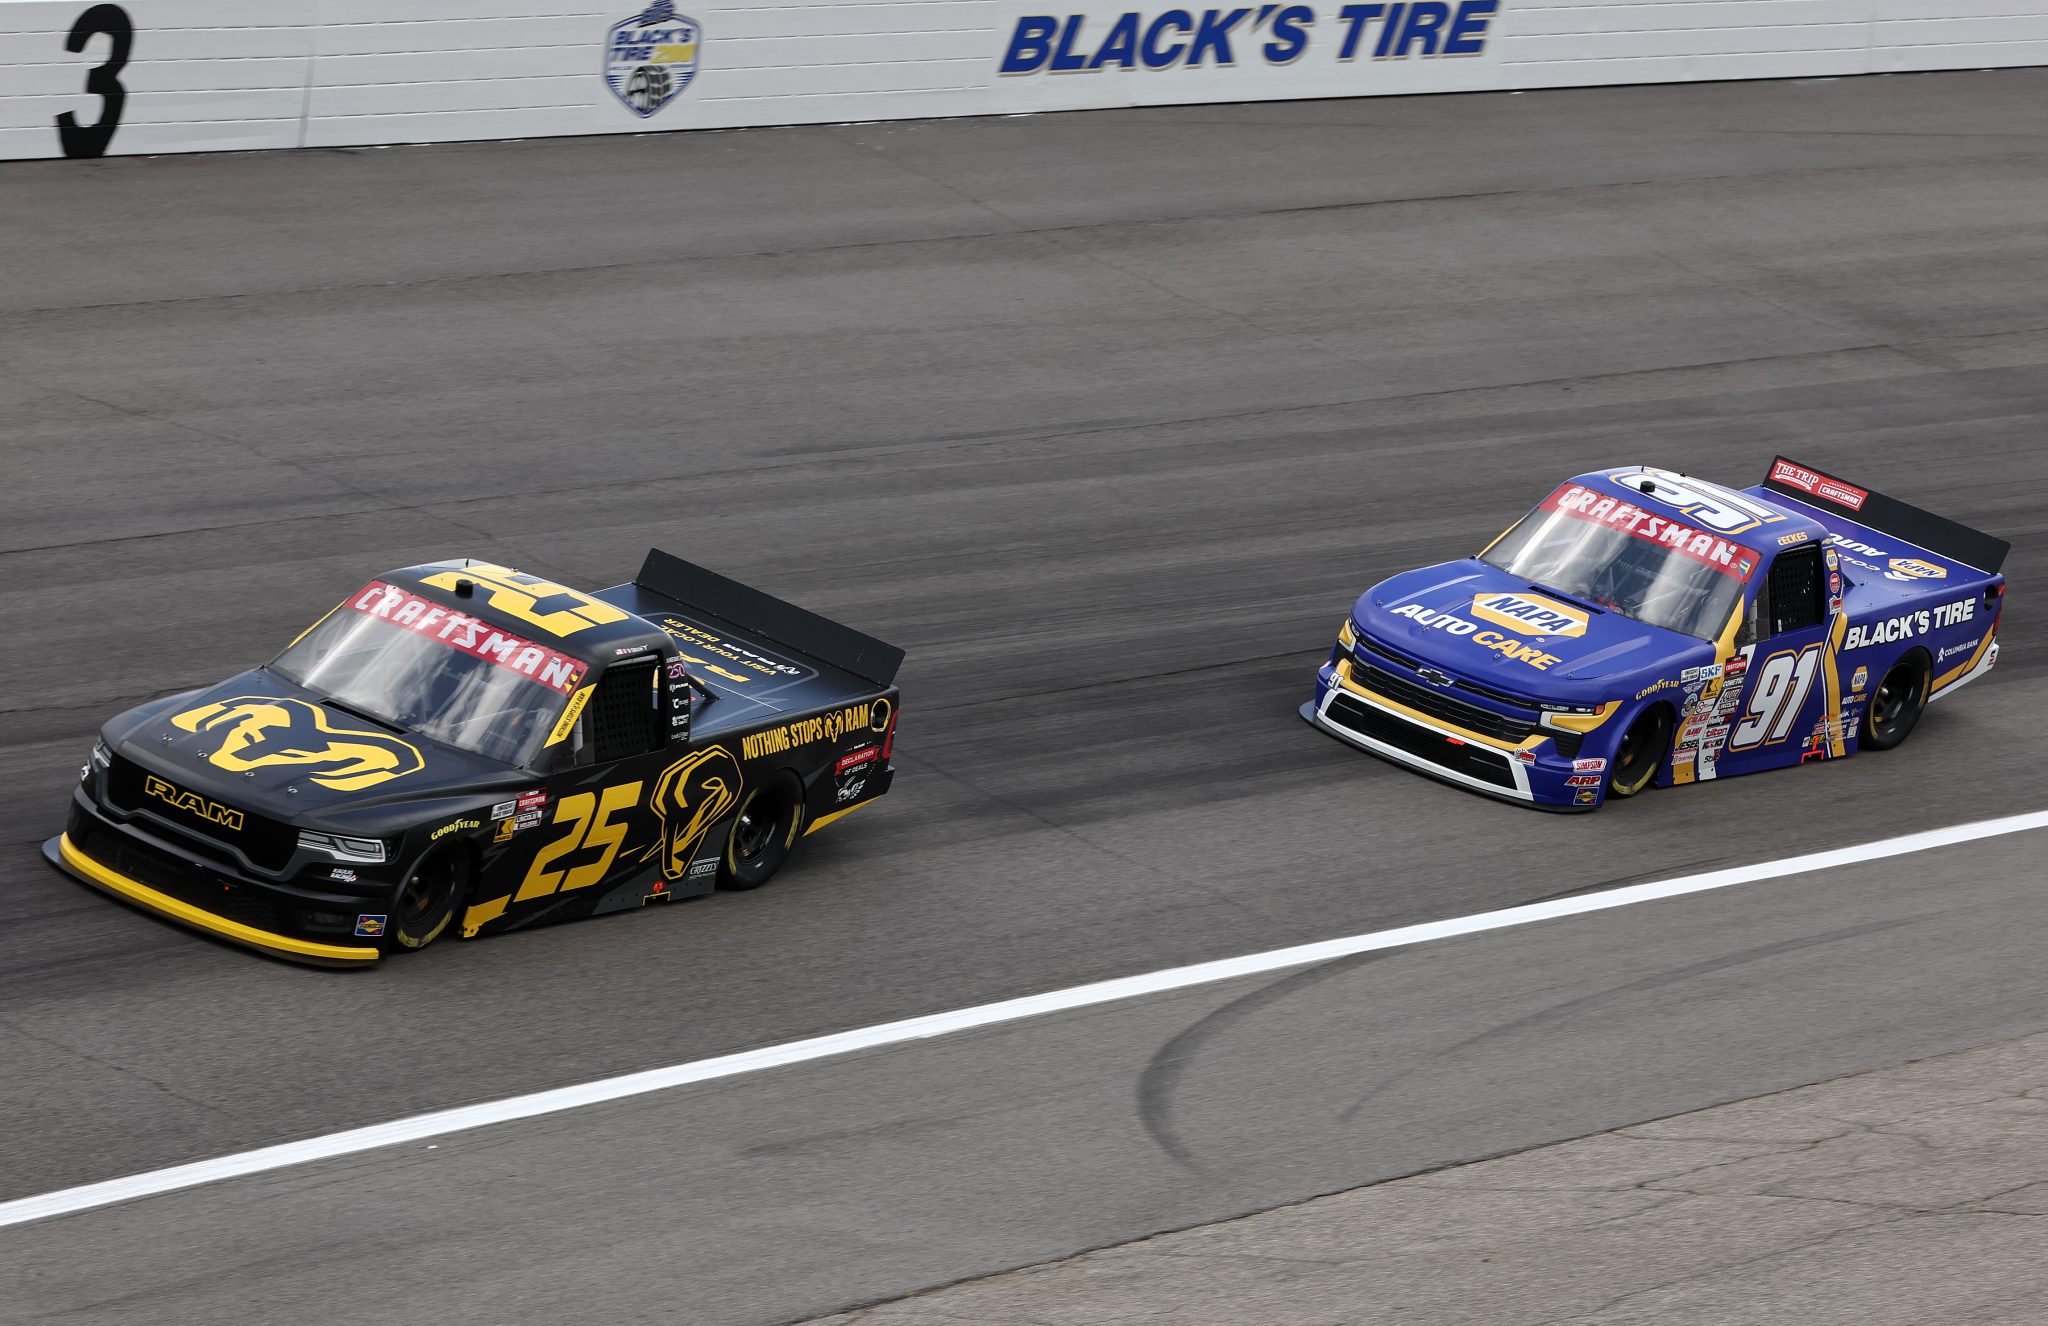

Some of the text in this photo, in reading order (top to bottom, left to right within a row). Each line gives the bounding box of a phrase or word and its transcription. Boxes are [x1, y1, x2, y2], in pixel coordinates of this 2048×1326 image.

[999, 0, 1499, 75] BLACK'S TIRE
[54, 3, 134, 158] 3
[1776, 462, 1796, 476] THE
[1796, 469, 1819, 486] TRIP
[1821, 487, 1859, 505] CRAFTSMAN
[1558, 487, 1738, 567] CRAFTSMAN
[1896, 560, 1940, 576] NAPA
[1484, 595, 1576, 632] NAPA
[1844, 598, 1976, 651] BLACK'S TIRE
[355, 587, 574, 689] CRAFTSMAN
[663, 618, 721, 643] DEALER
[1390, 604, 1563, 671] AUTO CARE
[659, 624, 778, 676] VISIT YOUR LOCAL
[1944, 638, 1979, 657] COLUMBIA BANK
[1328, 672, 1344, 691] 91
[1701, 665, 1722, 679] SKF
[1636, 679, 1680, 700] GOODYEAR
[1731, 645, 1821, 750] 91
[1841, 693, 1868, 705] AUTO CARE
[742, 703, 869, 761] NOTHING STOPS RAM
[841, 749, 875, 766] DECLARATION
[852, 762, 868, 773] DEALS
[1577, 761, 1602, 770] SIMPSON
[1568, 776, 1600, 785] ARP
[145, 775, 244, 831] RAM
[431, 818, 480, 840] GOODYEAR
[513, 780, 644, 903] 25
[690, 861, 719, 874] GRIZZLY
